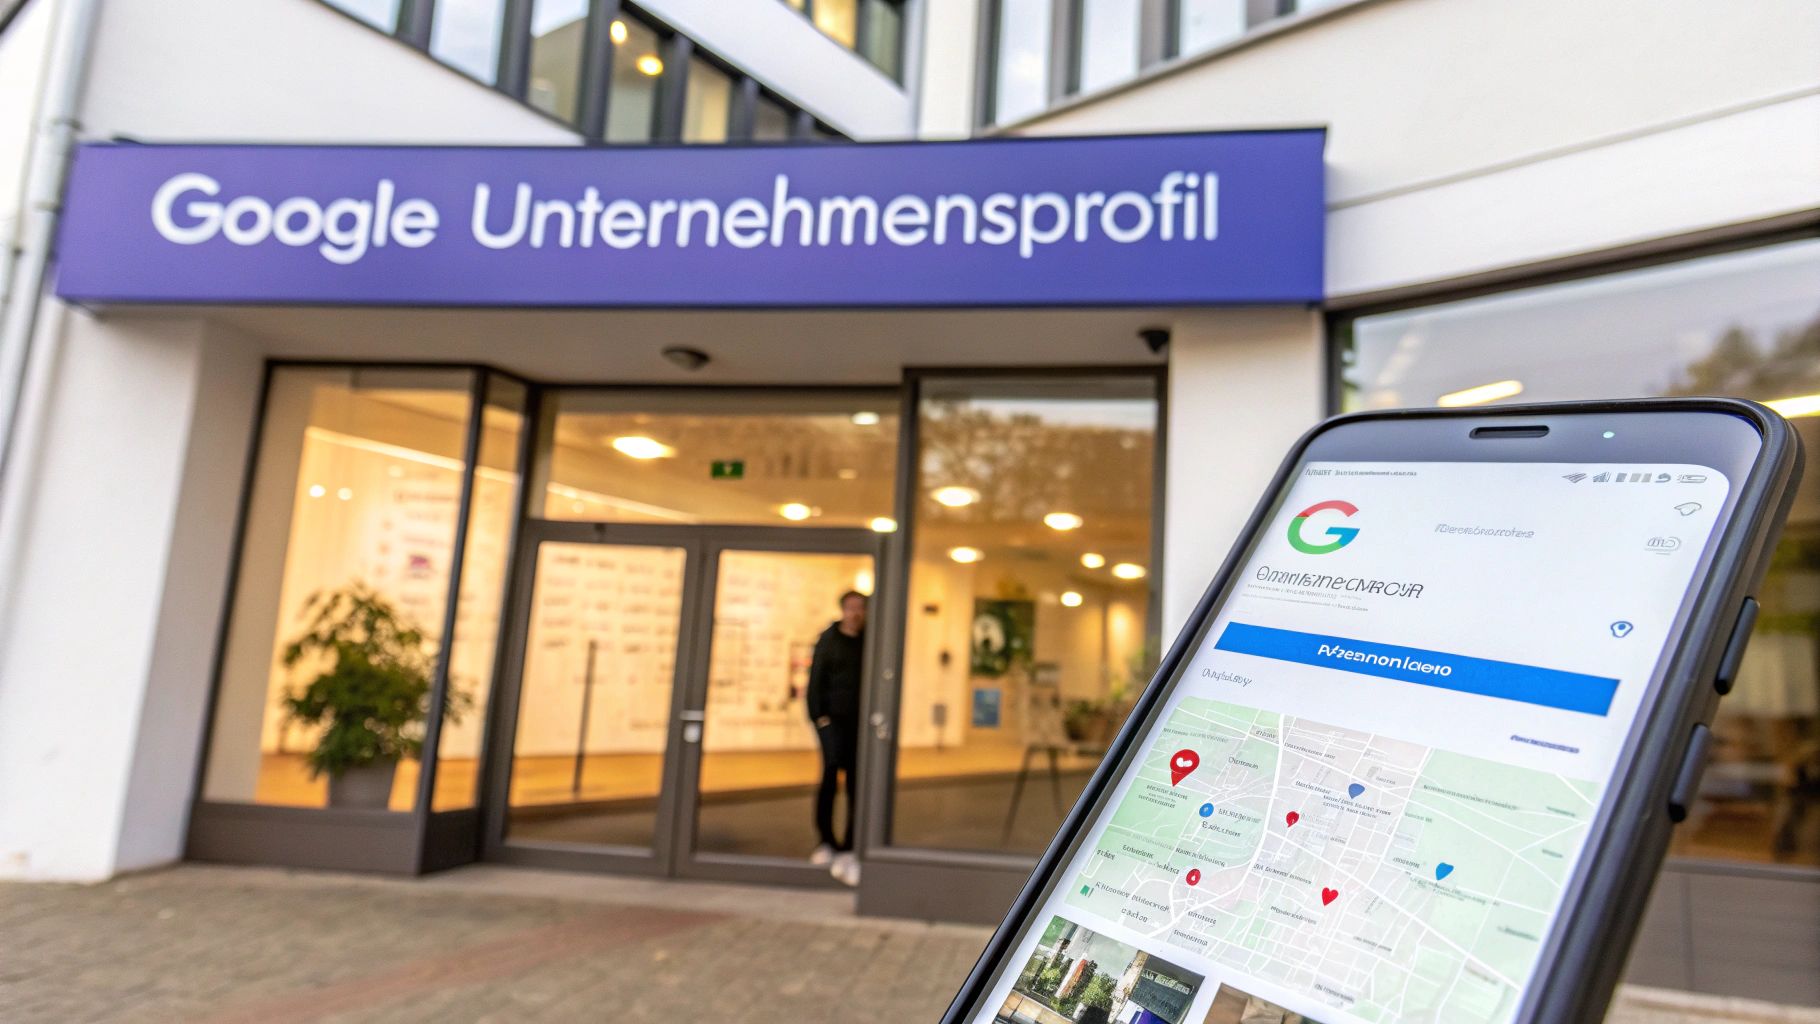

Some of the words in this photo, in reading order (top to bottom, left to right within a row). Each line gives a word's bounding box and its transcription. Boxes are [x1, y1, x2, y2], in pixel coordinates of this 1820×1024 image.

[151, 172, 439, 264] Google
[471, 170, 1219, 260] Unternehmensprofil
[1287, 500, 1360, 555] G
